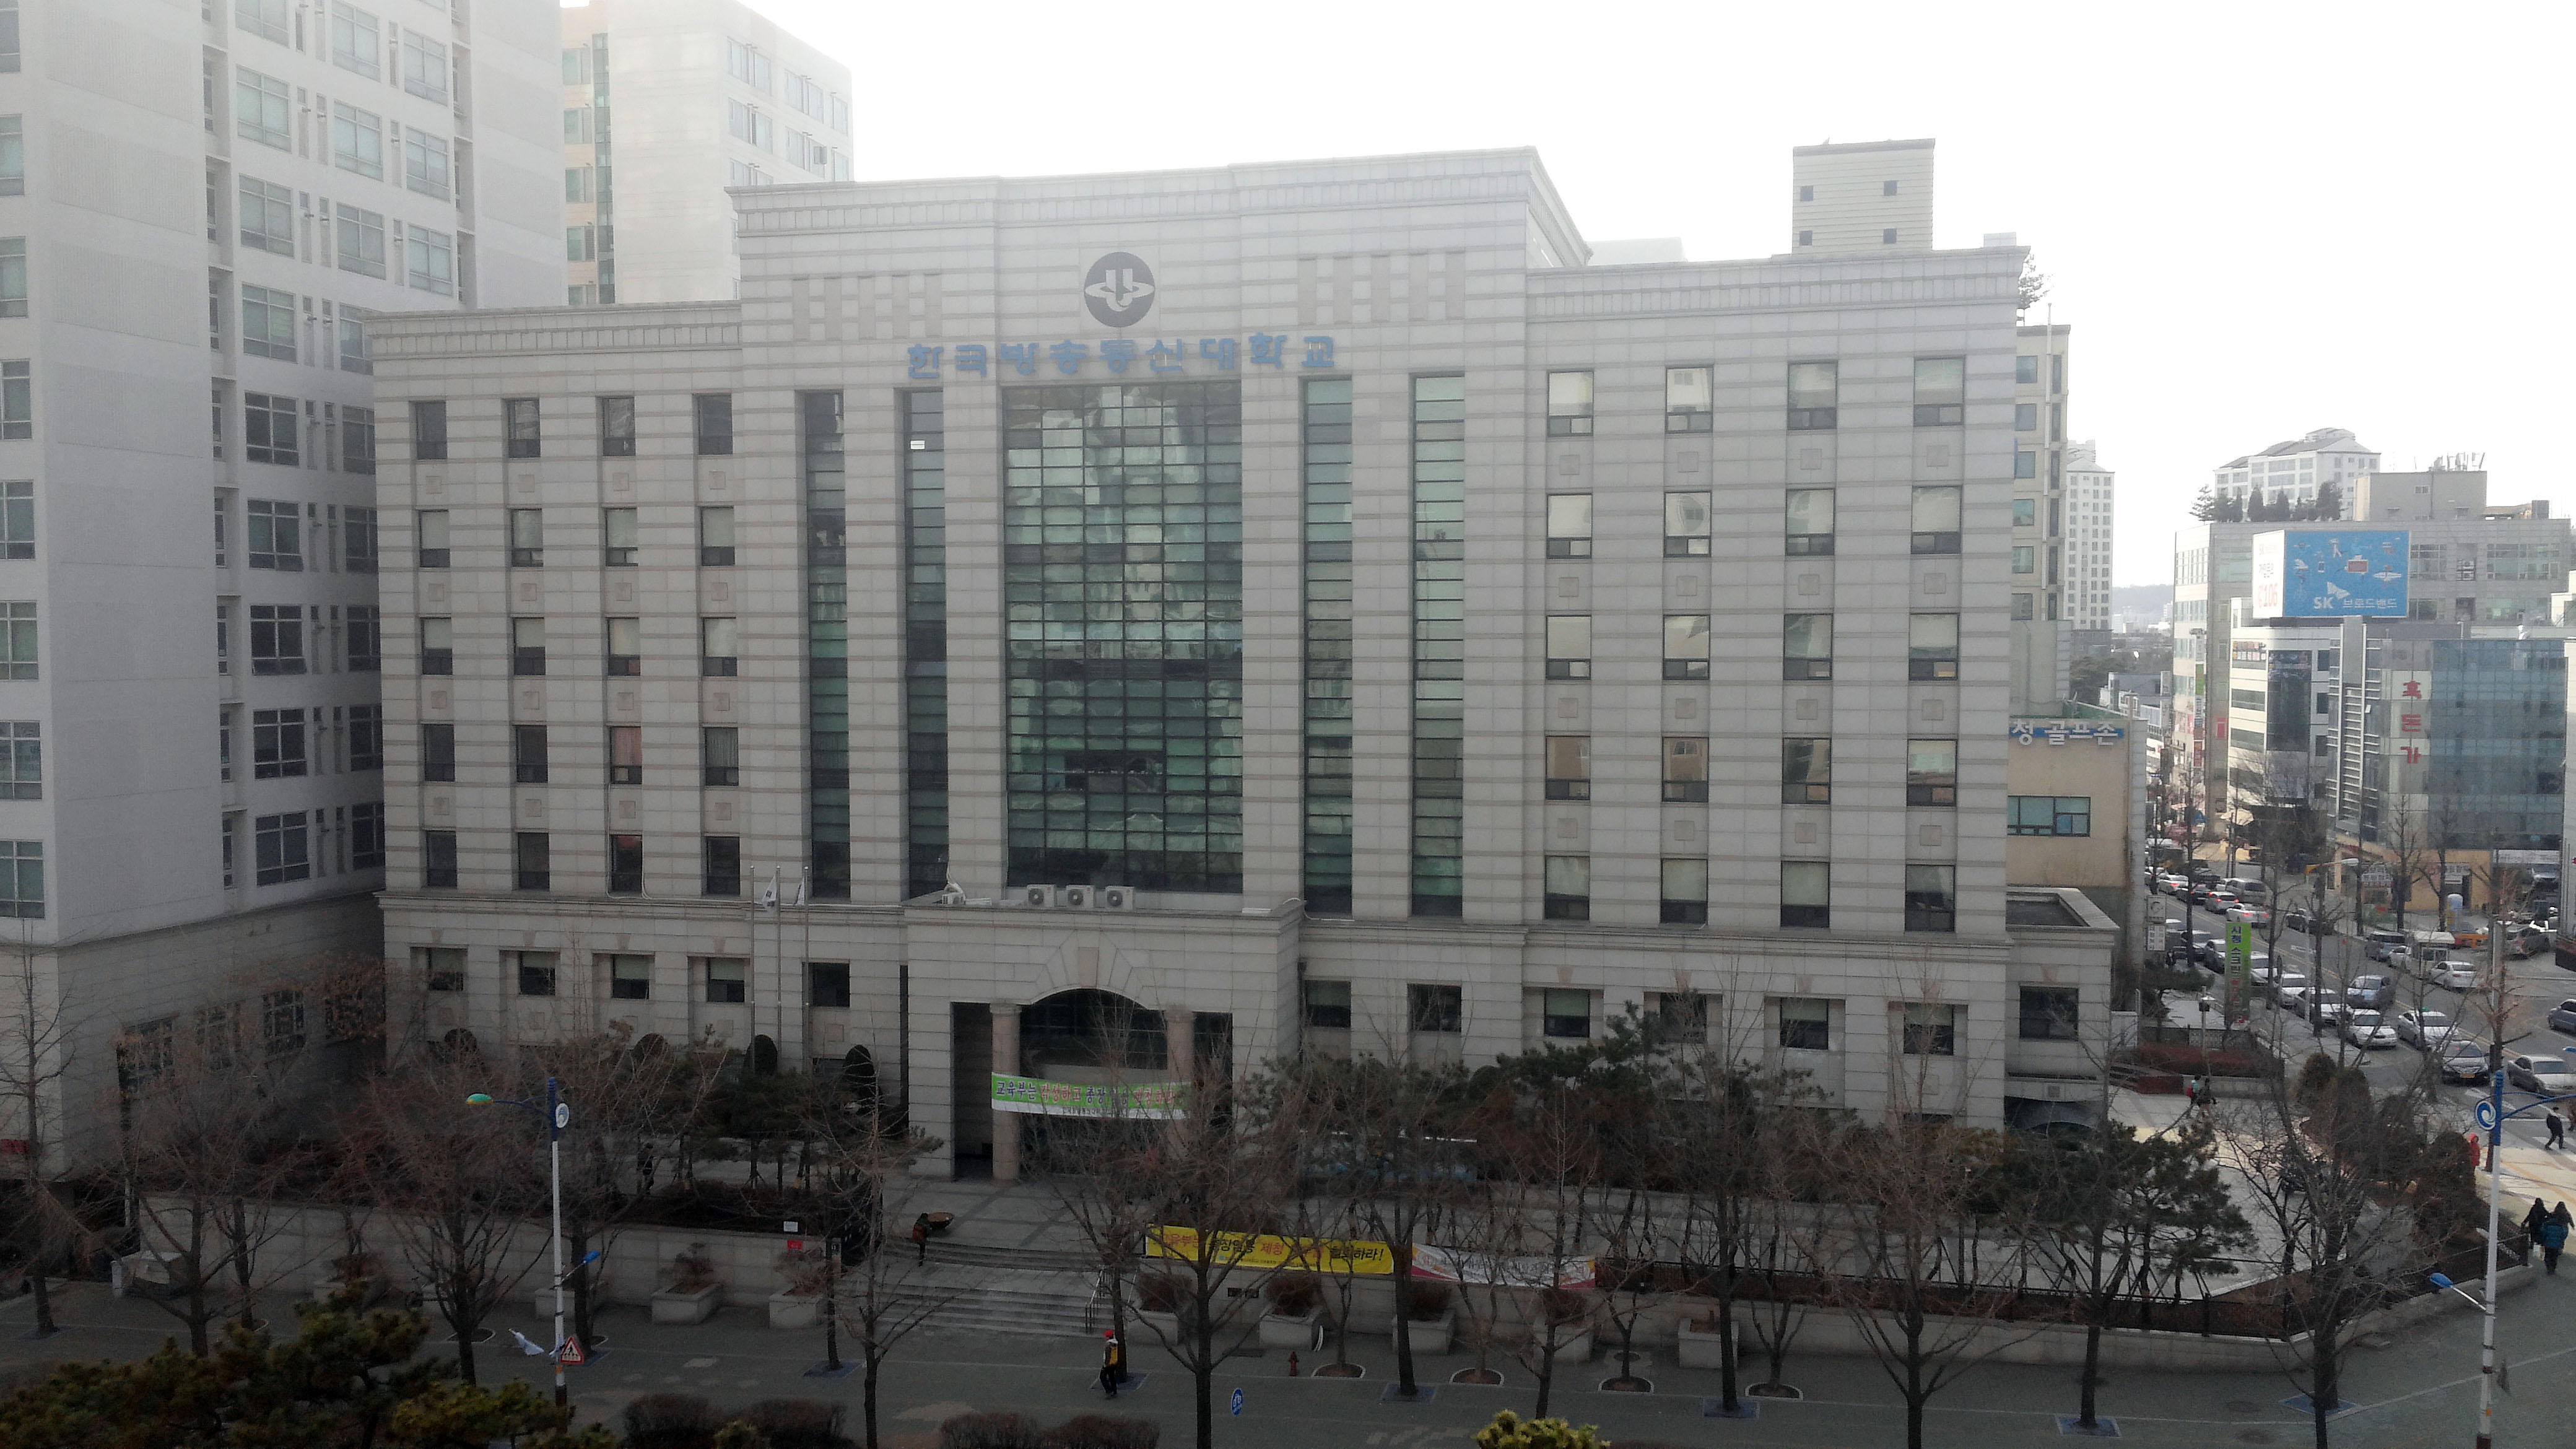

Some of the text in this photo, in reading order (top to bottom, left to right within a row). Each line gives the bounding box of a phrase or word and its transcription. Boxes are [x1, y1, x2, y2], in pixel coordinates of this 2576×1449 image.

[907, 332, 1335, 379] 한국방송통신대학교
[2313, 596, 2398, 609] SK 브로드밴드
[2044, 720, 2119, 747] 골프존
[996, 1080, 1037, 1101] 교육부는
[1086, 1085, 1106, 1105] 총장
